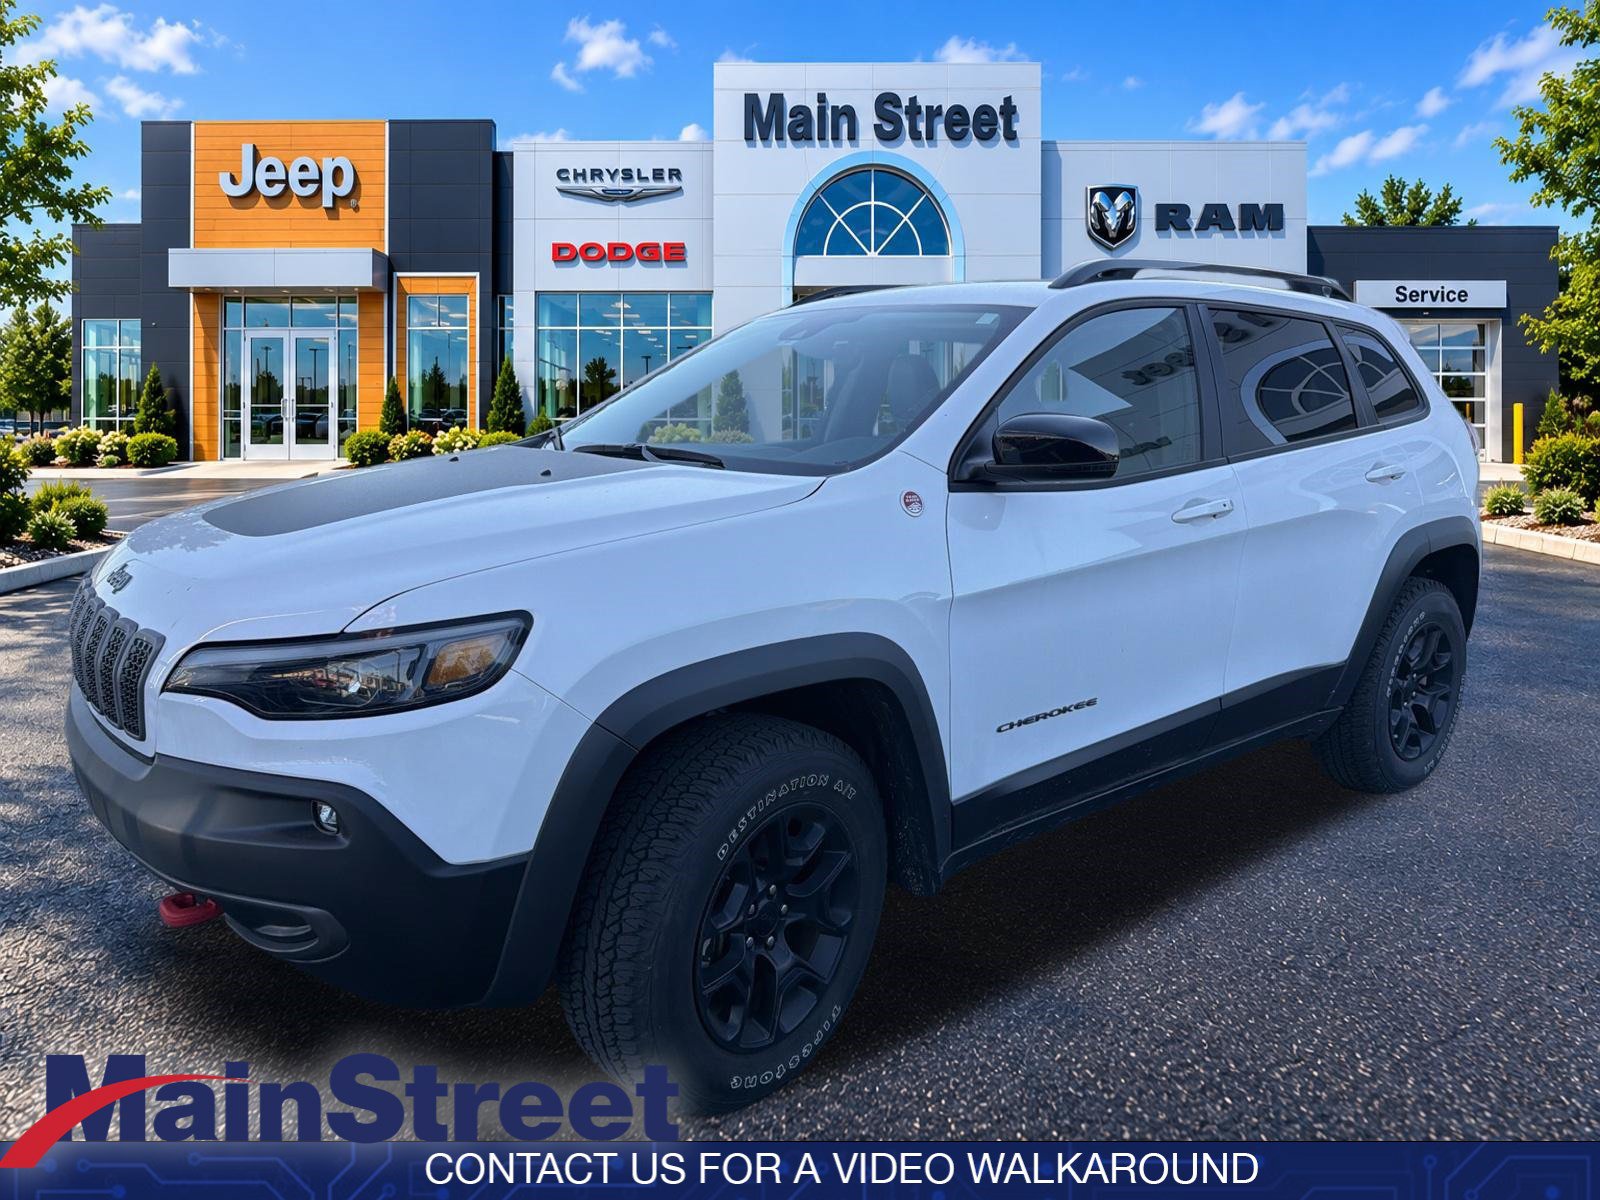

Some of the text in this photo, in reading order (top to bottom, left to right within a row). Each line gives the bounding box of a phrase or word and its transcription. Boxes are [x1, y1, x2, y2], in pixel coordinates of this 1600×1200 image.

[744, 91, 1018, 142] Main Street
[218, 143, 355, 209] Jeep
[556, 168, 682, 182] CHRYSLER
[1155, 203, 1284, 232] RAM
[551, 242, 686, 262] DODGE
[1395, 285, 1469, 303] Service
[996, 697, 1098, 733] CHEROKEE
[716, 773, 857, 861] DESTINATION A/T
